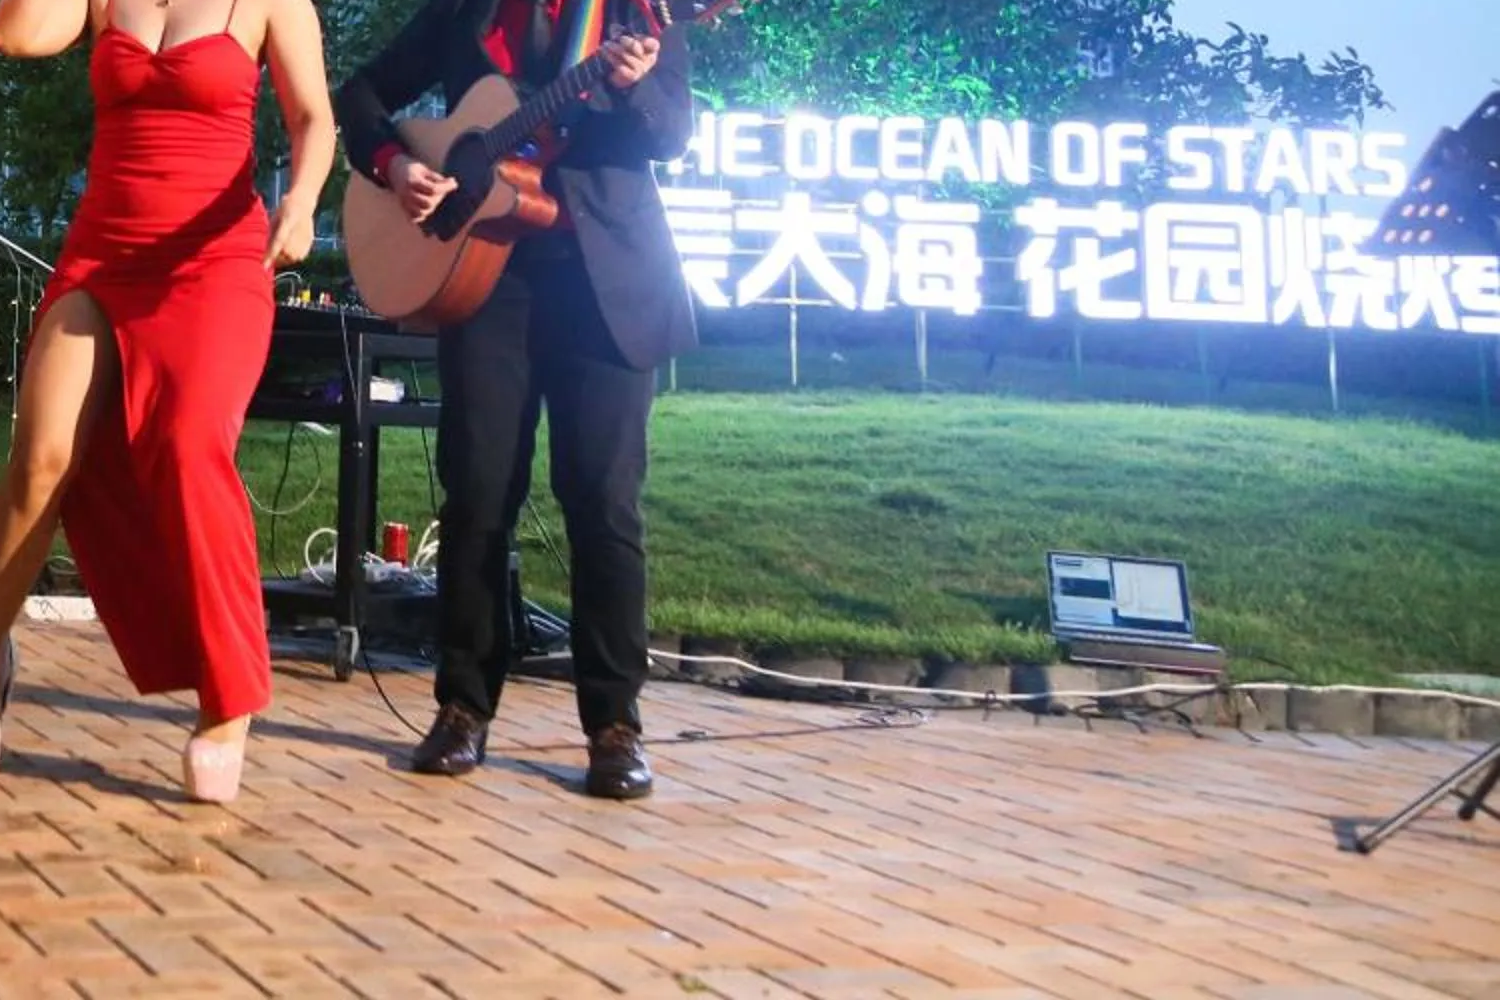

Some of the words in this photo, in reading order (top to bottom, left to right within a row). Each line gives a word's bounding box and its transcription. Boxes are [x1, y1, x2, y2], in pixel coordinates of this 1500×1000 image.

[784, 112, 1031, 185] OCEAN
[1052, 121, 1147, 187] OF
[1166, 125, 1407, 197] STARS
